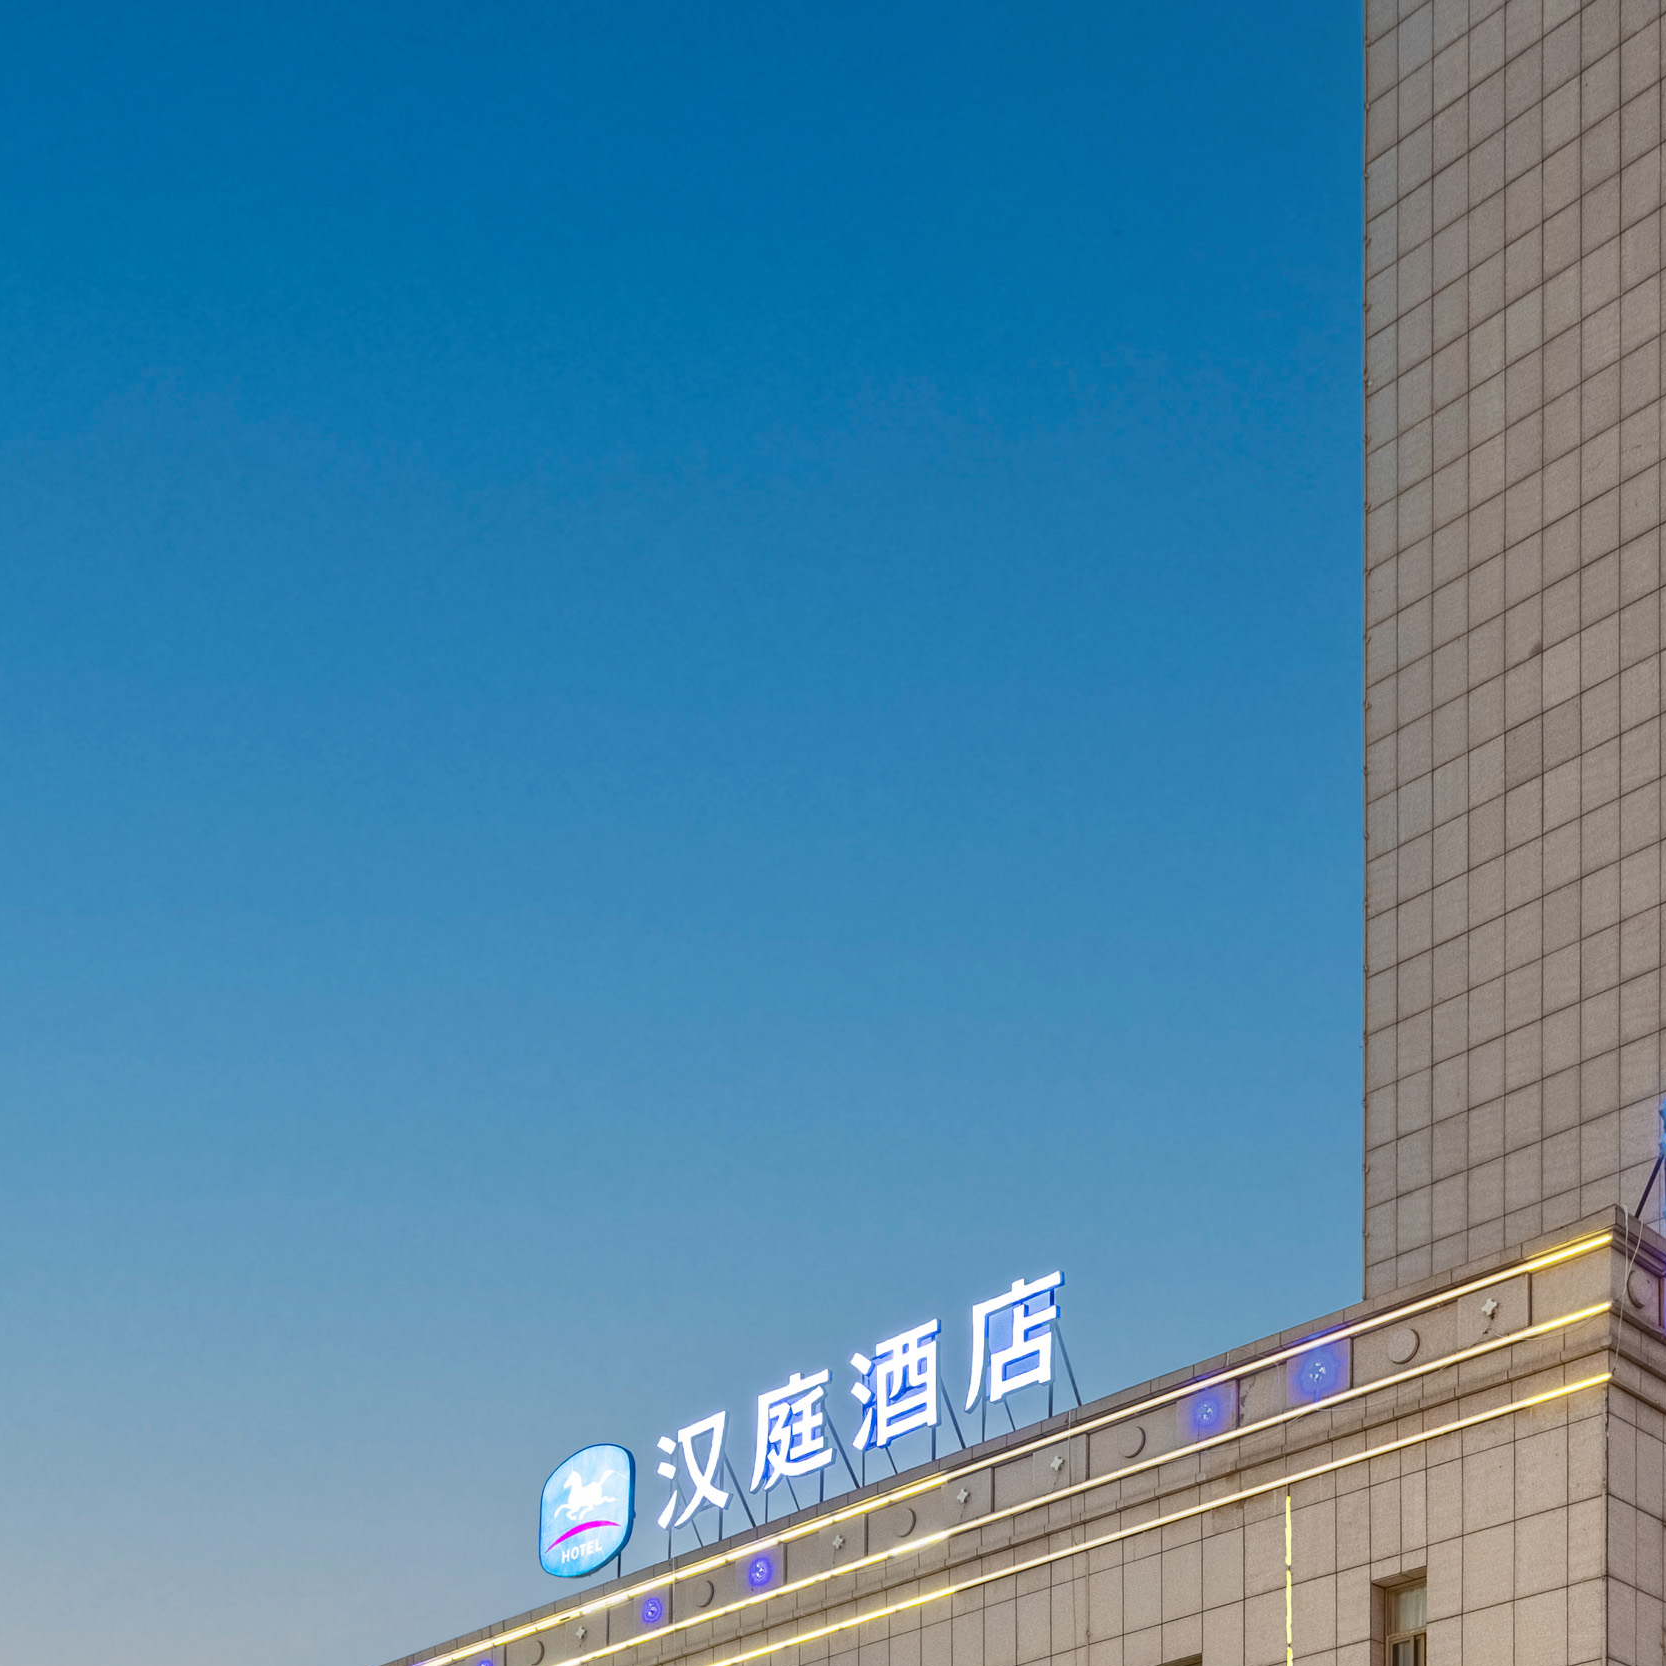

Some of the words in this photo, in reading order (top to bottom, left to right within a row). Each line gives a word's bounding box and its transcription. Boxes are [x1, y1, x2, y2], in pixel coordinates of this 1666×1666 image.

[656, 1270, 1065, 1530] 汉庭酒店
[561, 1539, 602, 1564] HOTEL
